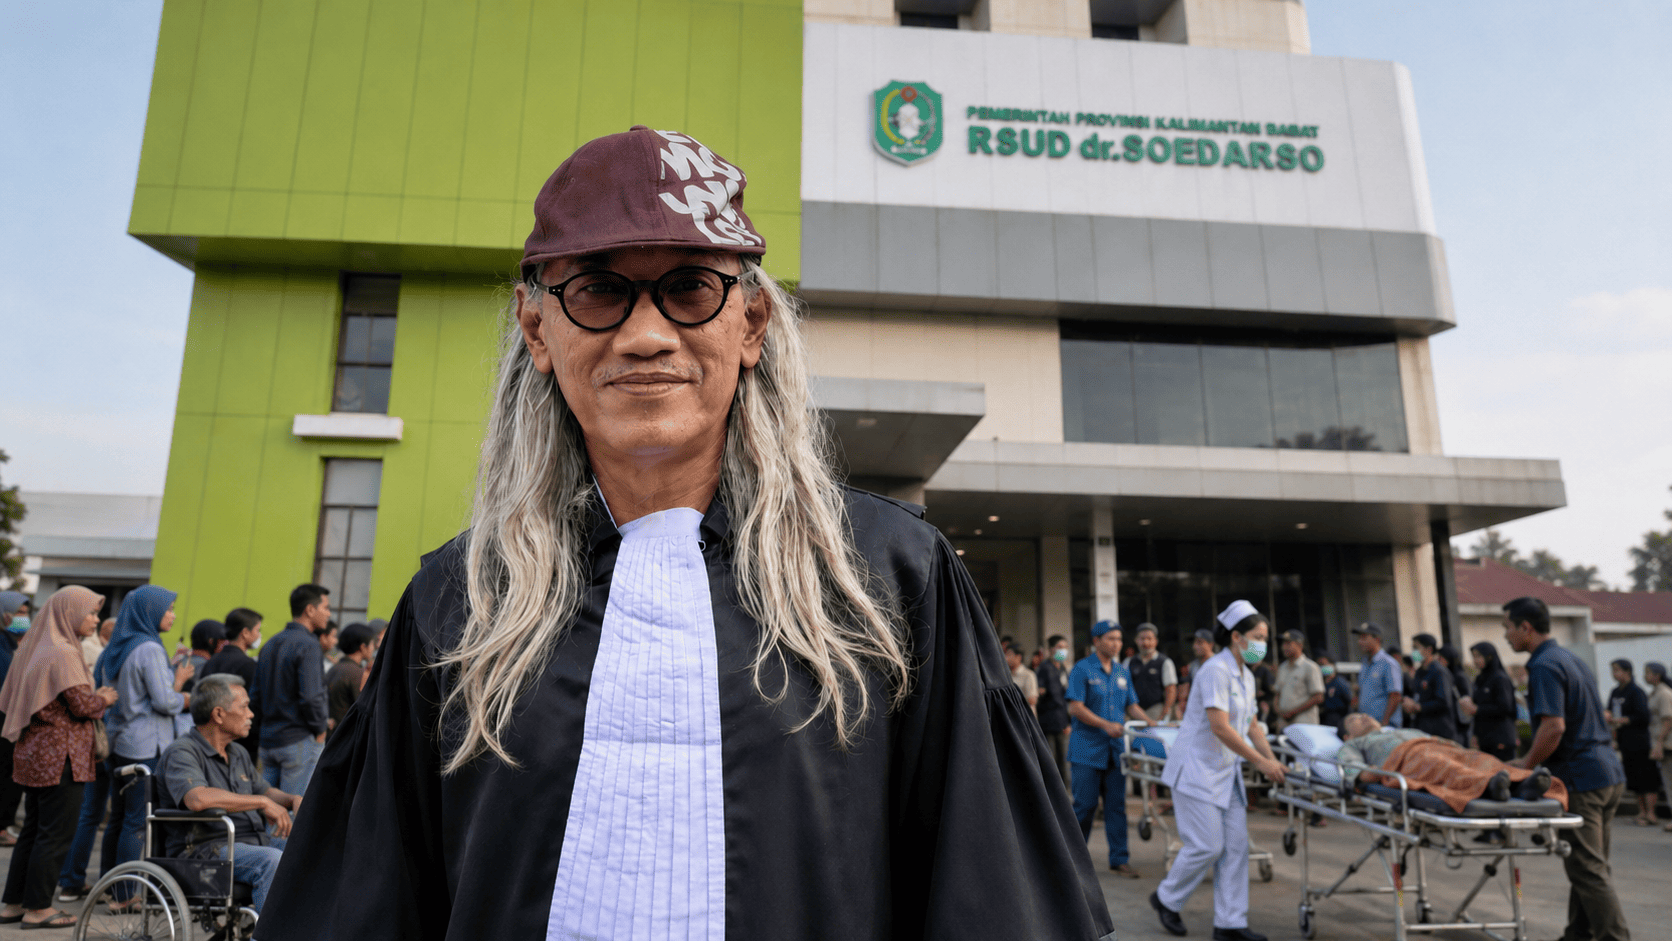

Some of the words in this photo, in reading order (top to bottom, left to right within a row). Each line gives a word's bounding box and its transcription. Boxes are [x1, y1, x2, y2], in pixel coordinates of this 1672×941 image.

[967, 106, 1070, 124] PEMERINTAH
[1155, 117, 1261, 136] KALIMANTAN
[967, 125, 1071, 158] RSUD
